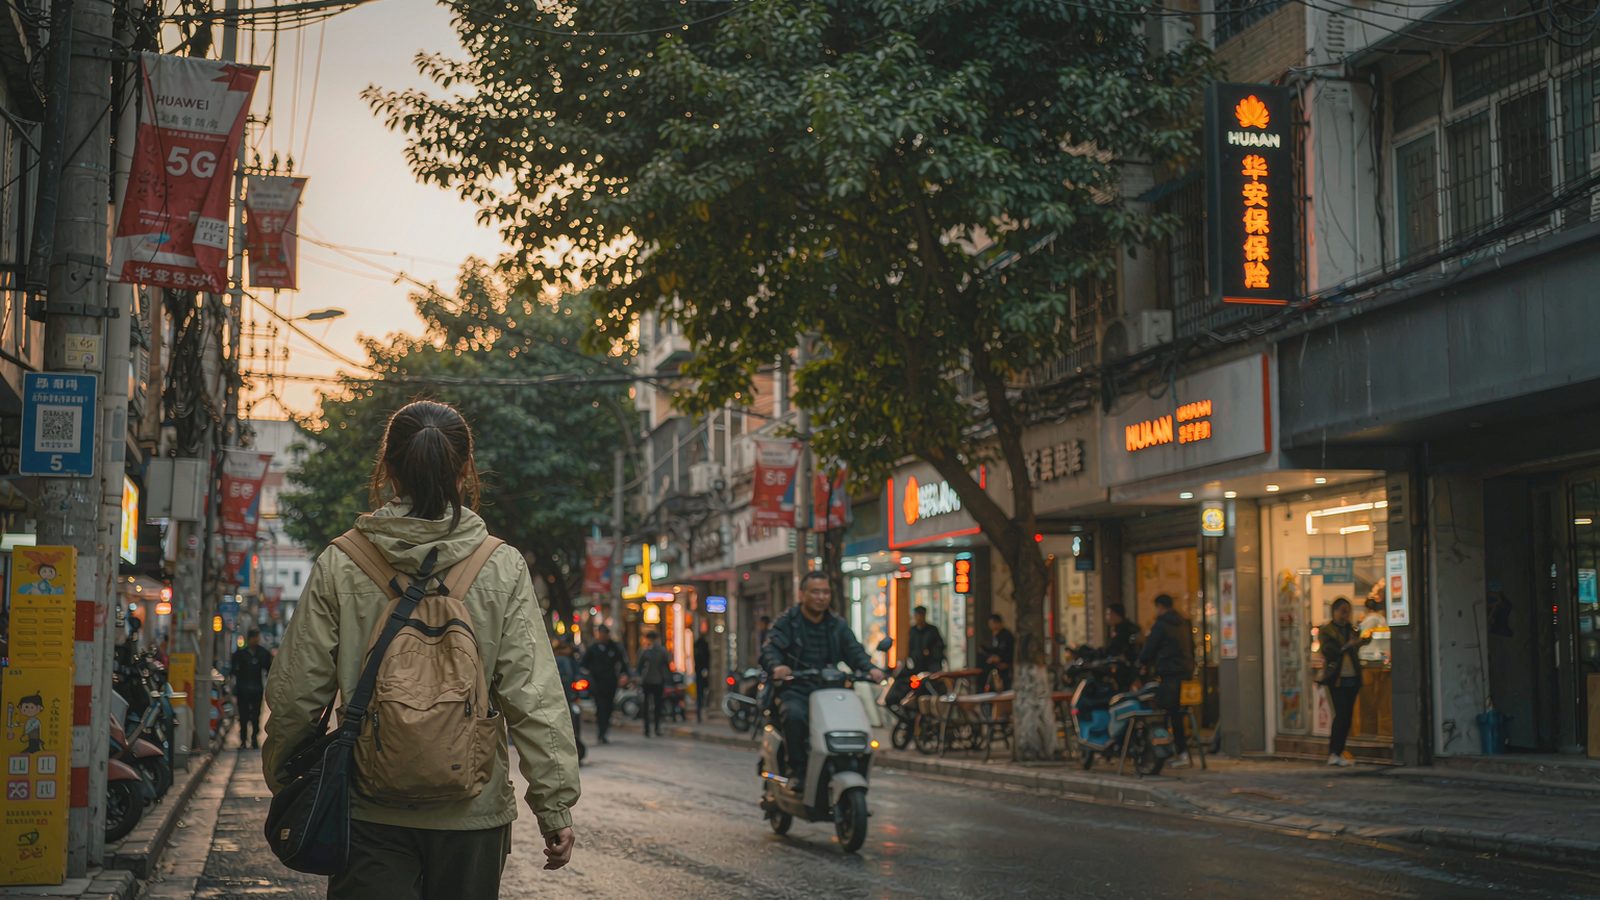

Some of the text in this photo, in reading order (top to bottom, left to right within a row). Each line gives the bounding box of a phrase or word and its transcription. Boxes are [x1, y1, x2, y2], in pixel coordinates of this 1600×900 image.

[156, 95, 209, 111] HUAWEI
[1228, 131, 1280, 148] HUAAN
[166, 146, 217, 179] 5G
[1241, 154, 1270, 289] 华安保保险
[50, 455, 63, 471] 5
